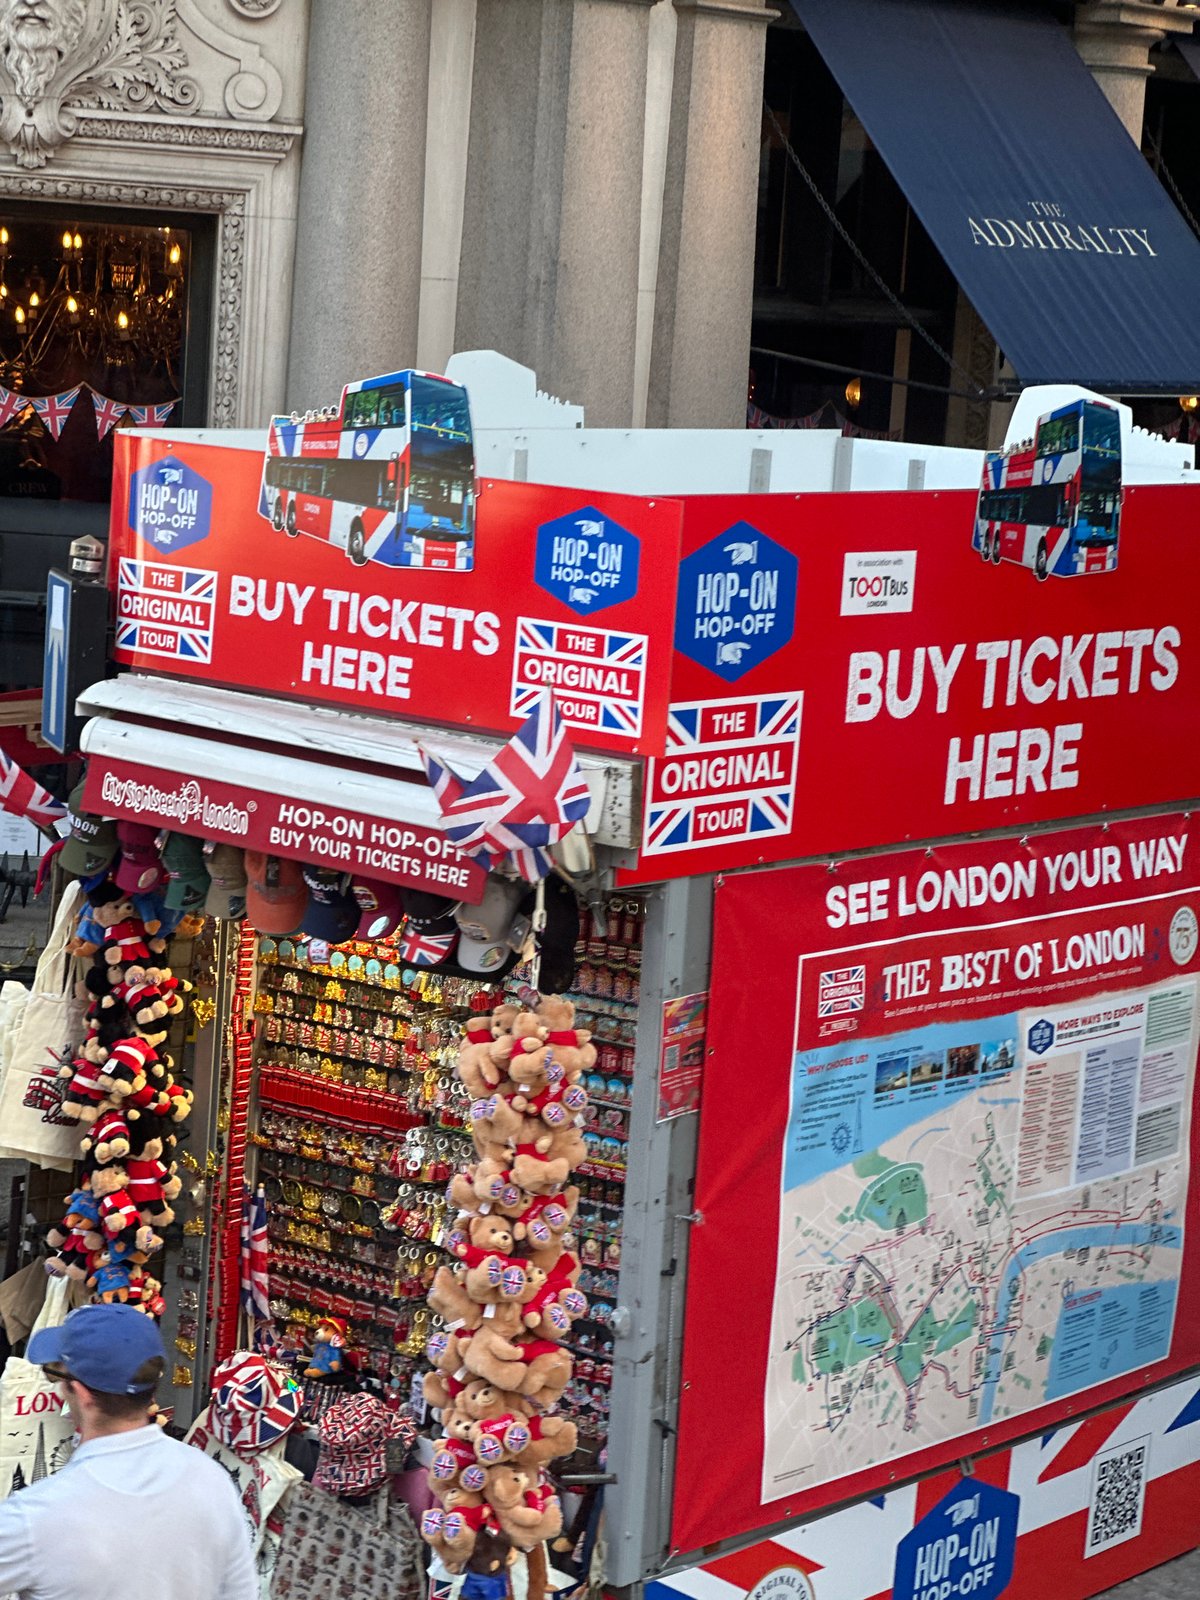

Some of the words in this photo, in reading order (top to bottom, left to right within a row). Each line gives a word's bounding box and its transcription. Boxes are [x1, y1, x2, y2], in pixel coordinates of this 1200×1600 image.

[1028, 201, 1066, 218] THE
[968, 216, 1158, 257] ADMIRALTY
[141, 483, 199, 517] HOP-ON
[139, 509, 197, 530] HOP-OFF
[552, 536, 623, 572] HOP-ON
[151, 571, 176, 588] THE
[550, 565, 621, 589] HOP-OFF
[696, 570, 777, 614] HOP-ON
[119, 595, 205, 627] ORIGINAL
[229, 575, 316, 624] BUY
[323, 589, 500, 655] TICKETS
[695, 615, 775, 640] HOP-OFF
[141, 630, 176, 649] TOUR
[565, 634, 596, 652] THE
[302, 642, 413, 699] HERE
[523, 658, 634, 695] ORIGINAL
[845, 643, 967, 724] BUY
[975, 625, 1182, 710] TICKETS
[711, 712, 745, 735] THE
[660, 750, 785, 794] ORIGINAL
[943, 723, 1084, 805] HERE
[201, 795, 249, 835] London
[697, 806, 745, 832] TOUR
[278, 804, 363, 842] HOP-ON
[370, 823, 470, 863] HOP-OFF
[270, 826, 306, 852] BUY
[308, 834, 350, 861] YOUR
[356, 845, 421, 874] TICKETS
[425, 862, 470, 888] HERE
[825, 878, 890, 929] SEE
[898, 859, 1037, 918] LONDON
[1043, 846, 1122, 894] YOUR
[1129, 833, 1189, 881] WAY
[882, 959, 931, 1002] THE
[939, 948, 1010, 992] BEST
[1014, 942, 1043, 980] OF
[1049, 923, 1146, 974] LONDON
[823, 983, 862, 999] ORIGINAL
[1057, 1018, 1080, 1031] MORE
[1081, 1013, 1101, 1026] WAYS
[1103, 1011, 1112, 1021] TO
[1113, 1003, 1144, 1019] EXPLORE
[807, 1063, 825, 1075] WHY
[825, 1056, 854, 1072] CHOOSE
[14, 1391, 65, 1416] LON
[914, 1517, 1000, 1590] HOP-ON
